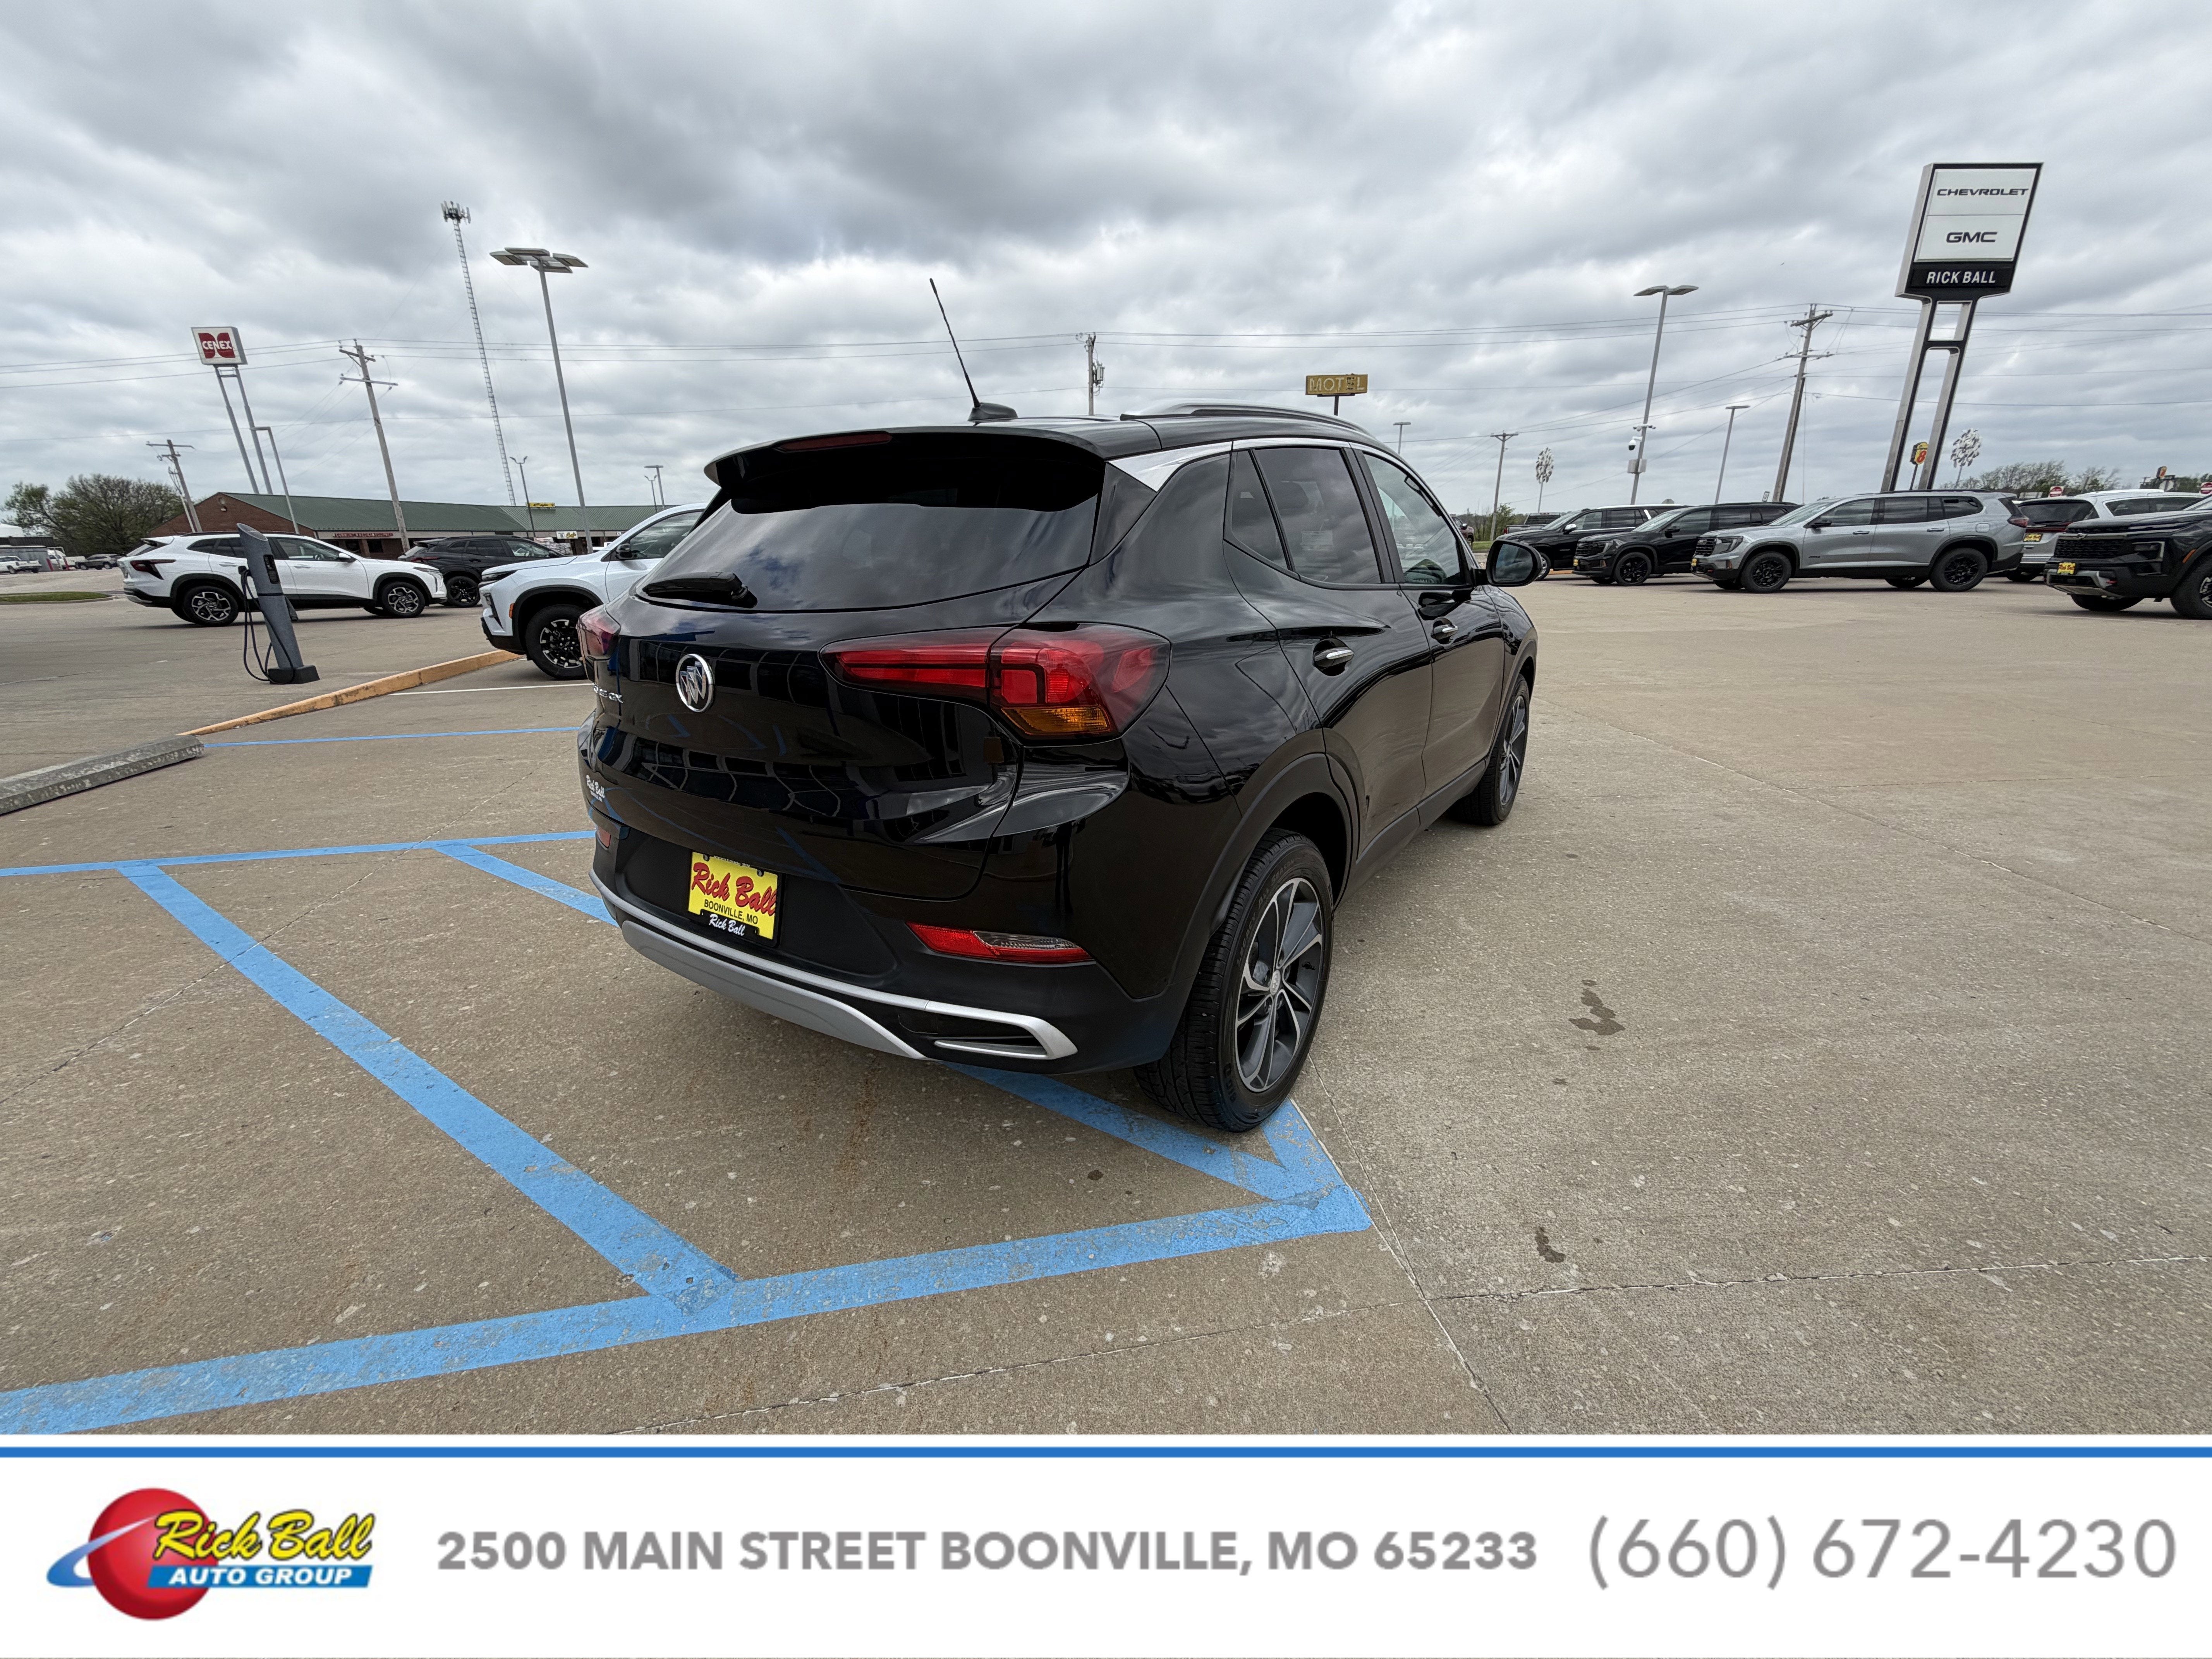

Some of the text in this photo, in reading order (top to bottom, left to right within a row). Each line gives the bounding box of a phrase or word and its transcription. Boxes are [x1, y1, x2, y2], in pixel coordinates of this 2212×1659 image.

[1946, 232, 1998, 243] GMC
[1926, 271, 1996, 284] RICK BALL
[202, 340, 233, 350] CENEX
[1309, 377, 1365, 391] MOTEL
[1917, 450, 1927, 463] 8
[691, 862, 778, 916] Rick Ball
[704, 899, 758, 925] BOONVILLE, MO
[709, 914, 746, 936] Rick Ball
